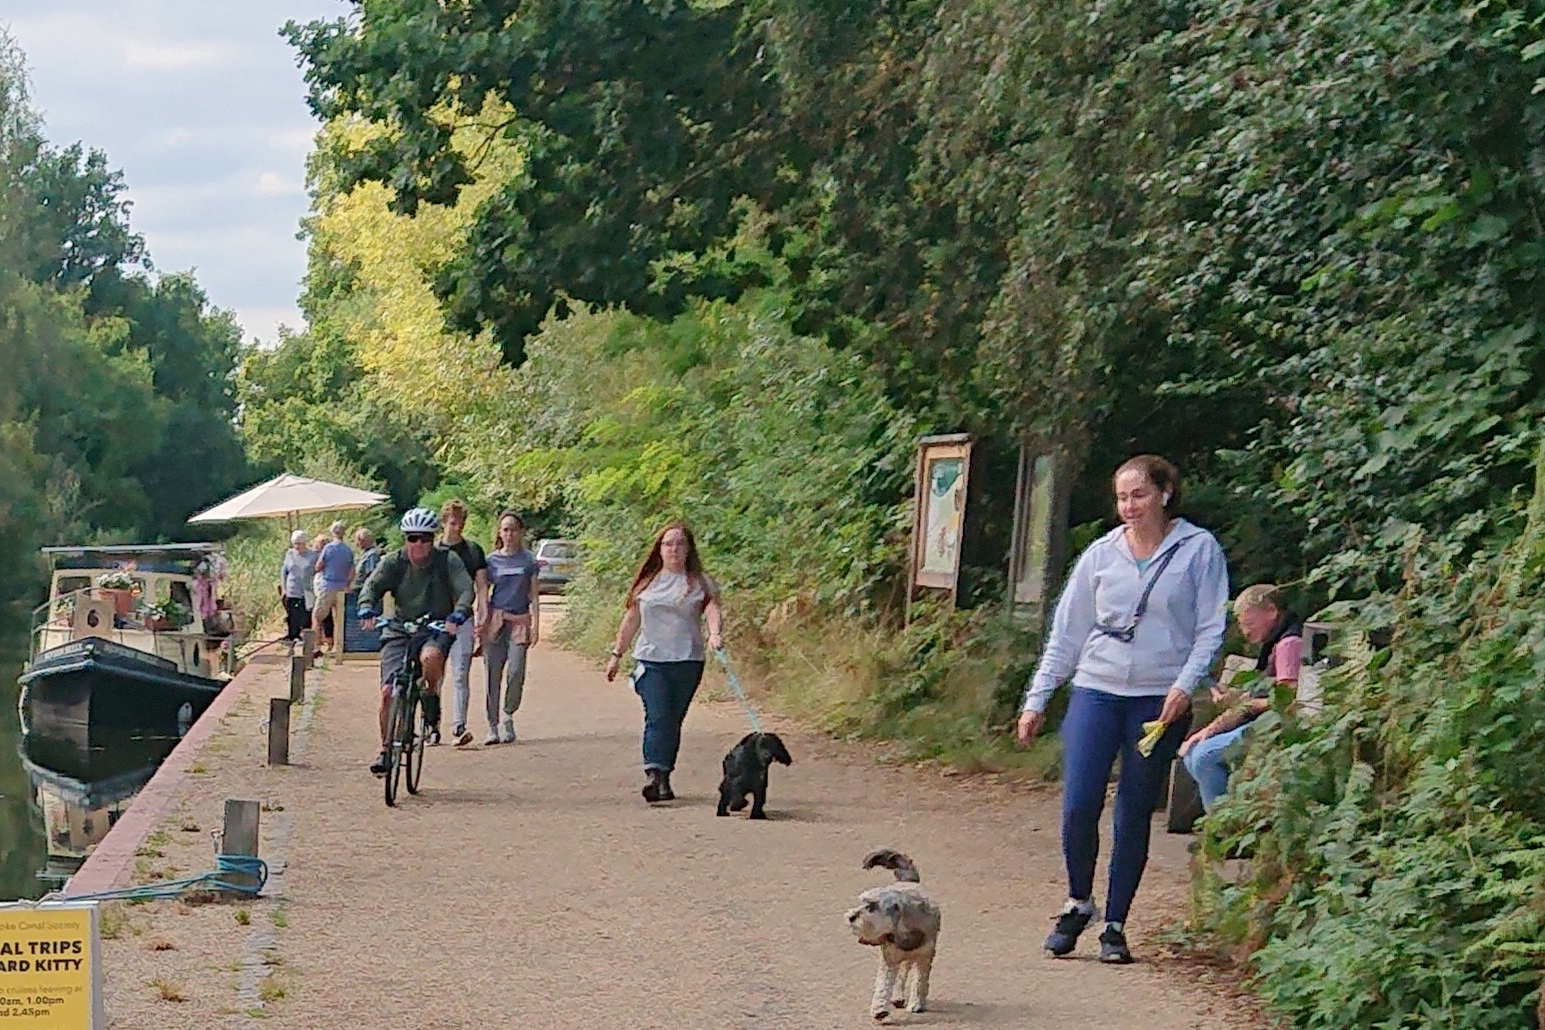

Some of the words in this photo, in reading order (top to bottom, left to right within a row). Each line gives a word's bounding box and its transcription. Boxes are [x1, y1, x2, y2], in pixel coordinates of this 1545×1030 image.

[18, 921, 45, 931] Canal
[28, 940, 82, 955] TRIPS
[35, 958, 83, 972] KITTY
[26, 996, 64, 1007] 1.00pm
[12, 1007, 50, 1018] 2.45pm
